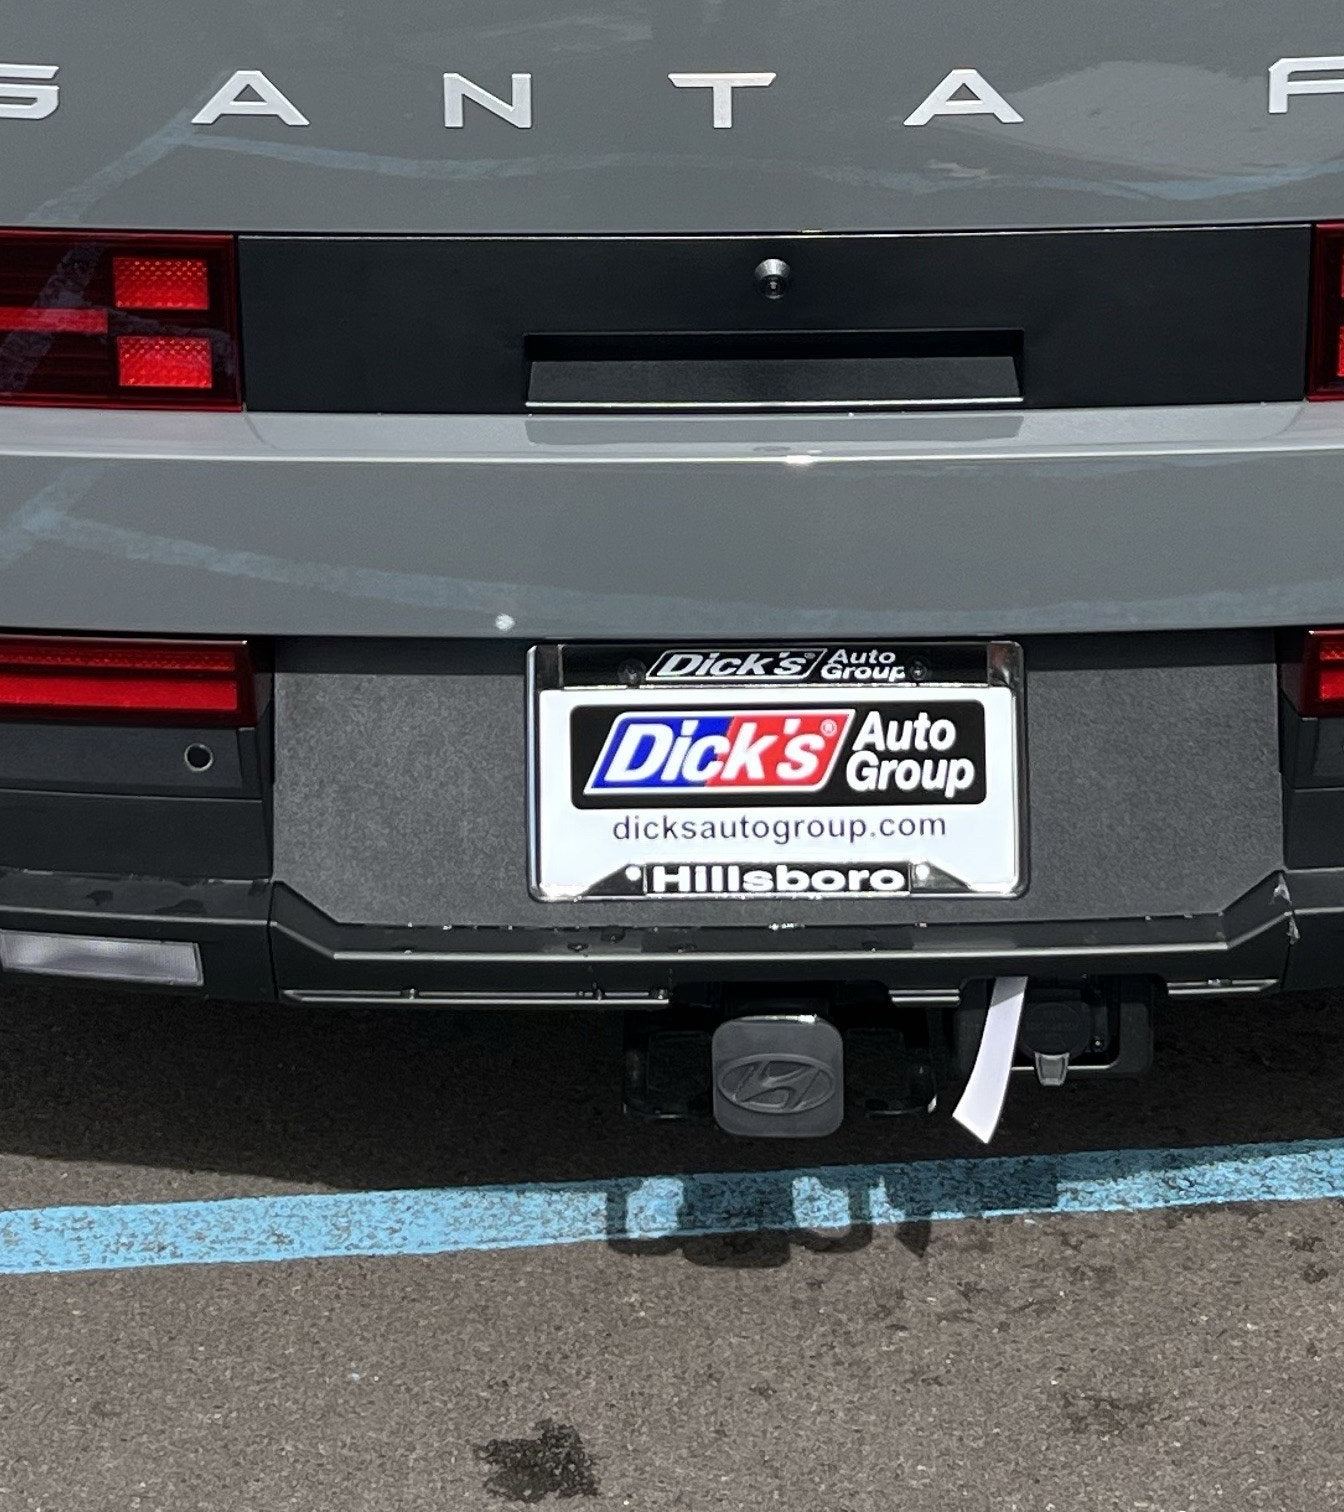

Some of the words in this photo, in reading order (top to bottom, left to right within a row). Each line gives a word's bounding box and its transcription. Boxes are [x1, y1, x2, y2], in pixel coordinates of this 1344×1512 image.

[656, 651, 807, 676] Dick's
[828, 648, 896, 664] Auto
[821, 663, 906, 683] Group
[853, 710, 956, 751] Auto
[603, 716, 826, 783] Dick's
[845, 751, 975, 798] Group
[612, 813, 947, 845] dicksautogroup.com
[652, 864, 906, 893] Hillsboro
